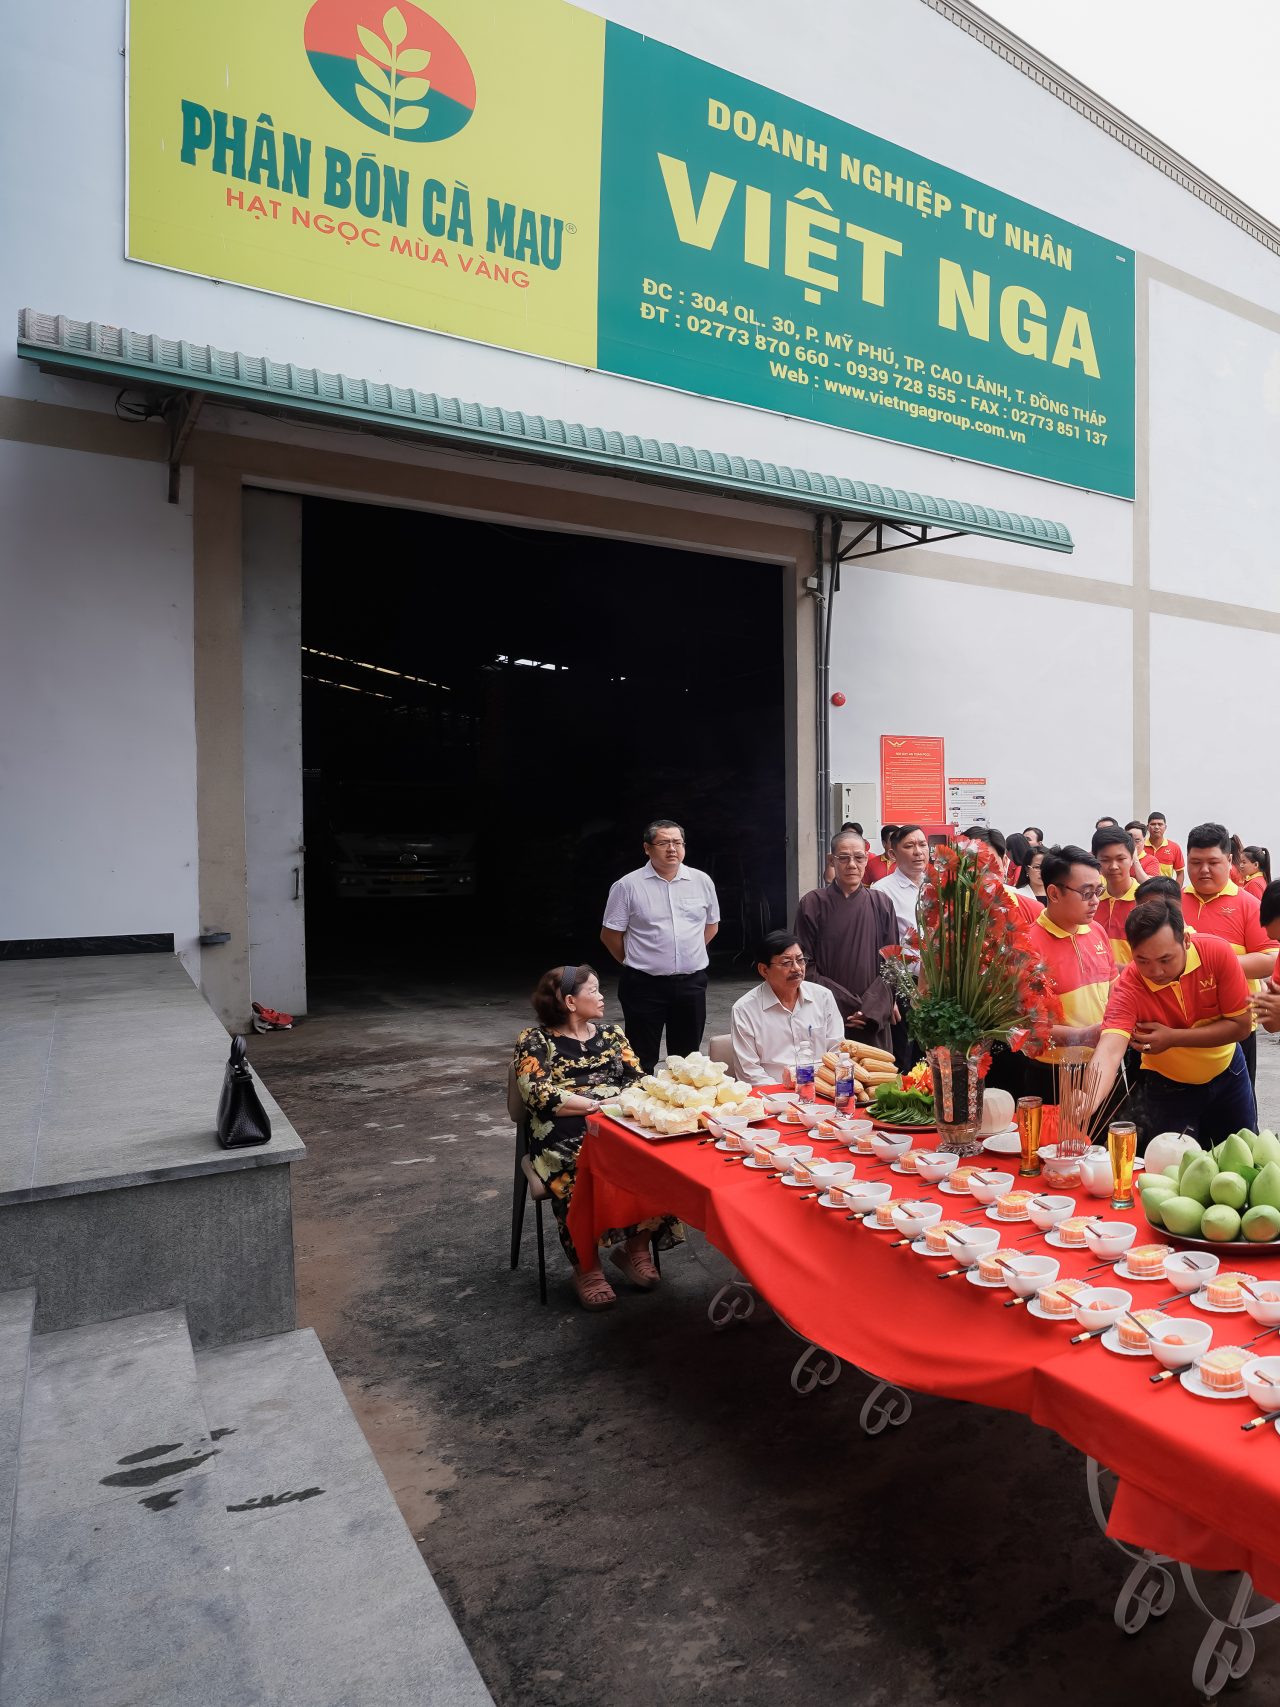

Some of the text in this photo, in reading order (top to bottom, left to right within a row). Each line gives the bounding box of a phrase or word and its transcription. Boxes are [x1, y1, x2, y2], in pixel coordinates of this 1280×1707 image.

[180, 98, 312, 198] PHÂN
[423, 178, 474, 247] CÀ
[226, 187, 531, 289] HẠT NGỌC MÙA VÀNG
[708, 98, 1072, 272] DOANH NGHIỆP TƯ NHÂN
[657, 152, 1101, 379] VIỆT NGA
[640, 302, 669, 324] ĐT
[687, 315, 750, 346] 02773
[755, 334, 790, 357] 870
[795, 346, 829, 368] 660
[847, 360, 889, 386] 0939
[893, 374, 923, 395] 728
[927, 384, 956, 404] 555
[971, 396, 1000, 417] FAX
[1011, 408, 1053, 432] 02773
[1057, 421, 1080, 440] 851
[1085, 429, 1108, 446] 137
[642, 278, 673, 300] ĐC
[690, 292, 729, 317] 304
[734, 305, 766, 328] QL.
[771, 316, 801, 340] 30,
[806, 325, 820, 343] P.
[825, 331, 854, 353] MỸ
[858, 343, 900, 370] PHÚ,
[904, 355, 926, 375] TP.
[931, 364, 963, 385] CAO
[967, 374, 1013, 403] LÃNH,
[1016, 389, 1027, 405] T.
[1030, 391, 1069, 417] ĐỒNG
[1072, 406, 1107, 427] THÁP
[769, 360, 809, 385] Web
[824, 379, 1026, 444] www.vietngagroup.com.vn
